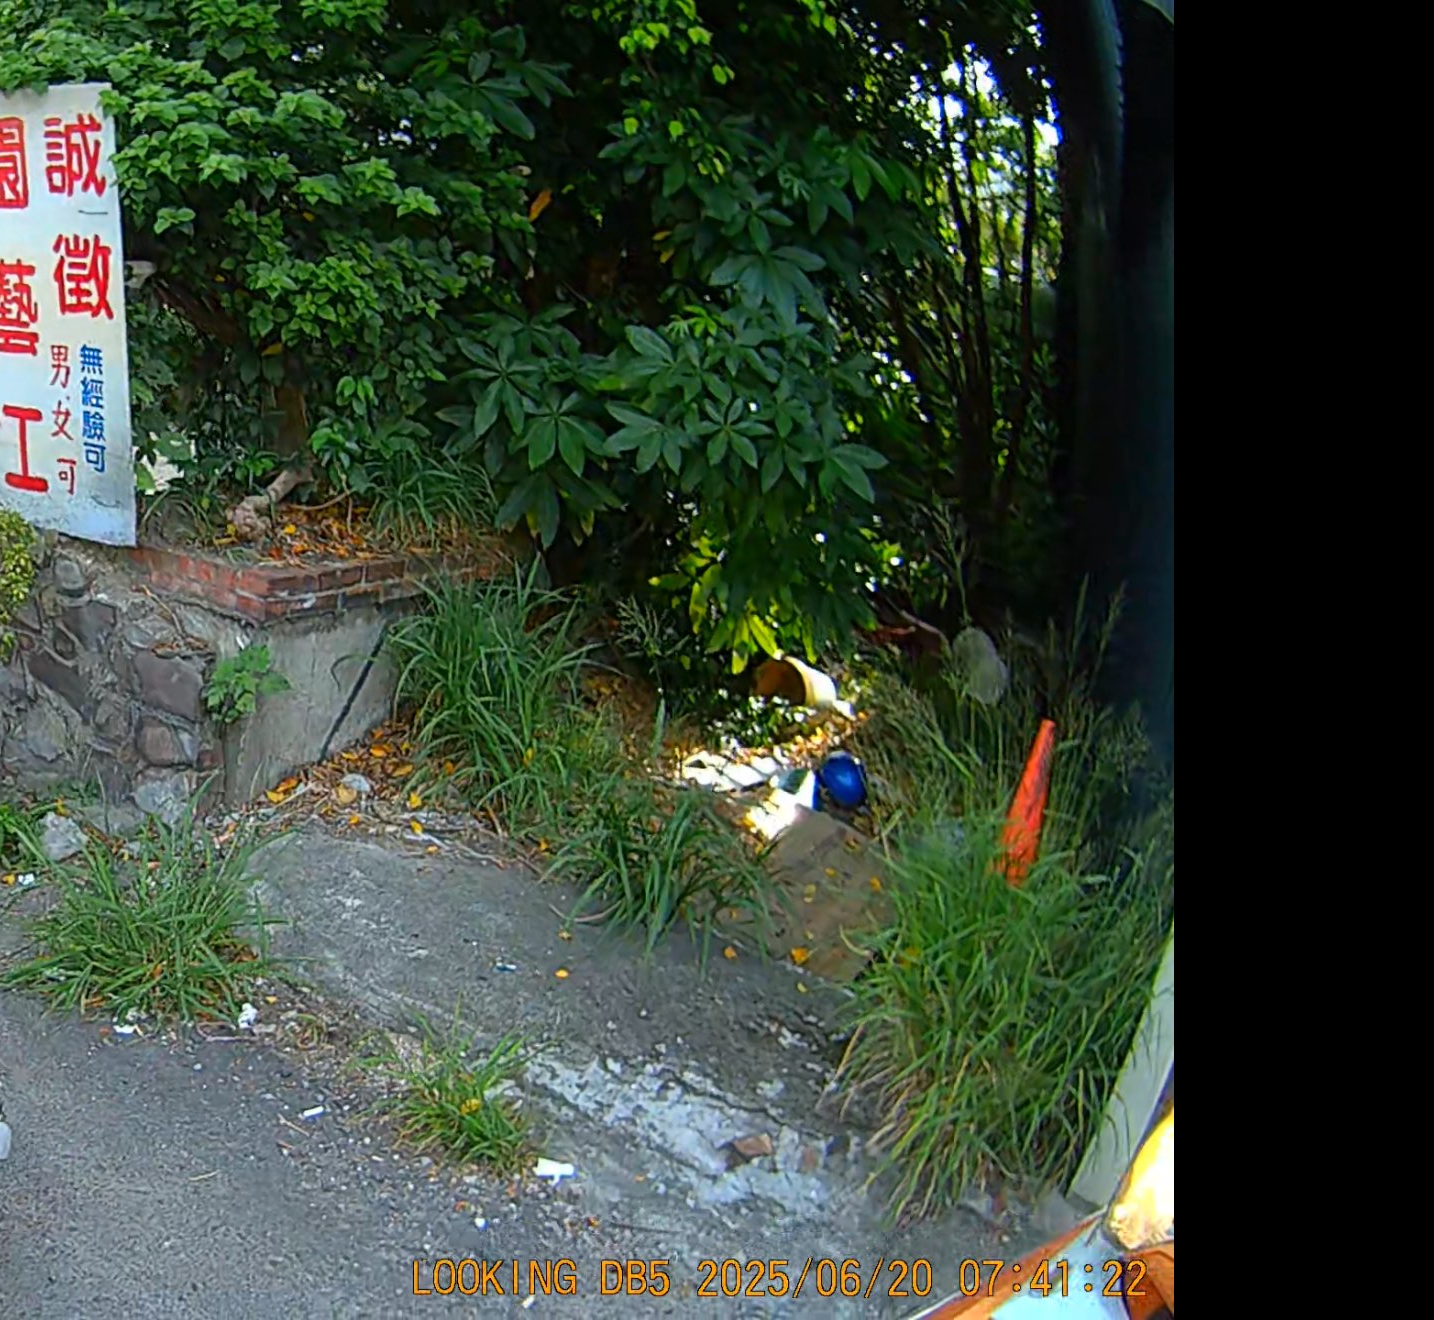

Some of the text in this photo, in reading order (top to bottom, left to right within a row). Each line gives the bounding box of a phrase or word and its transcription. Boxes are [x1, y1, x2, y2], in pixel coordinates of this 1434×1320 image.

[44, 112, 114, 320] 誠徵
[80, 343, 106, 473] 無經驗可
